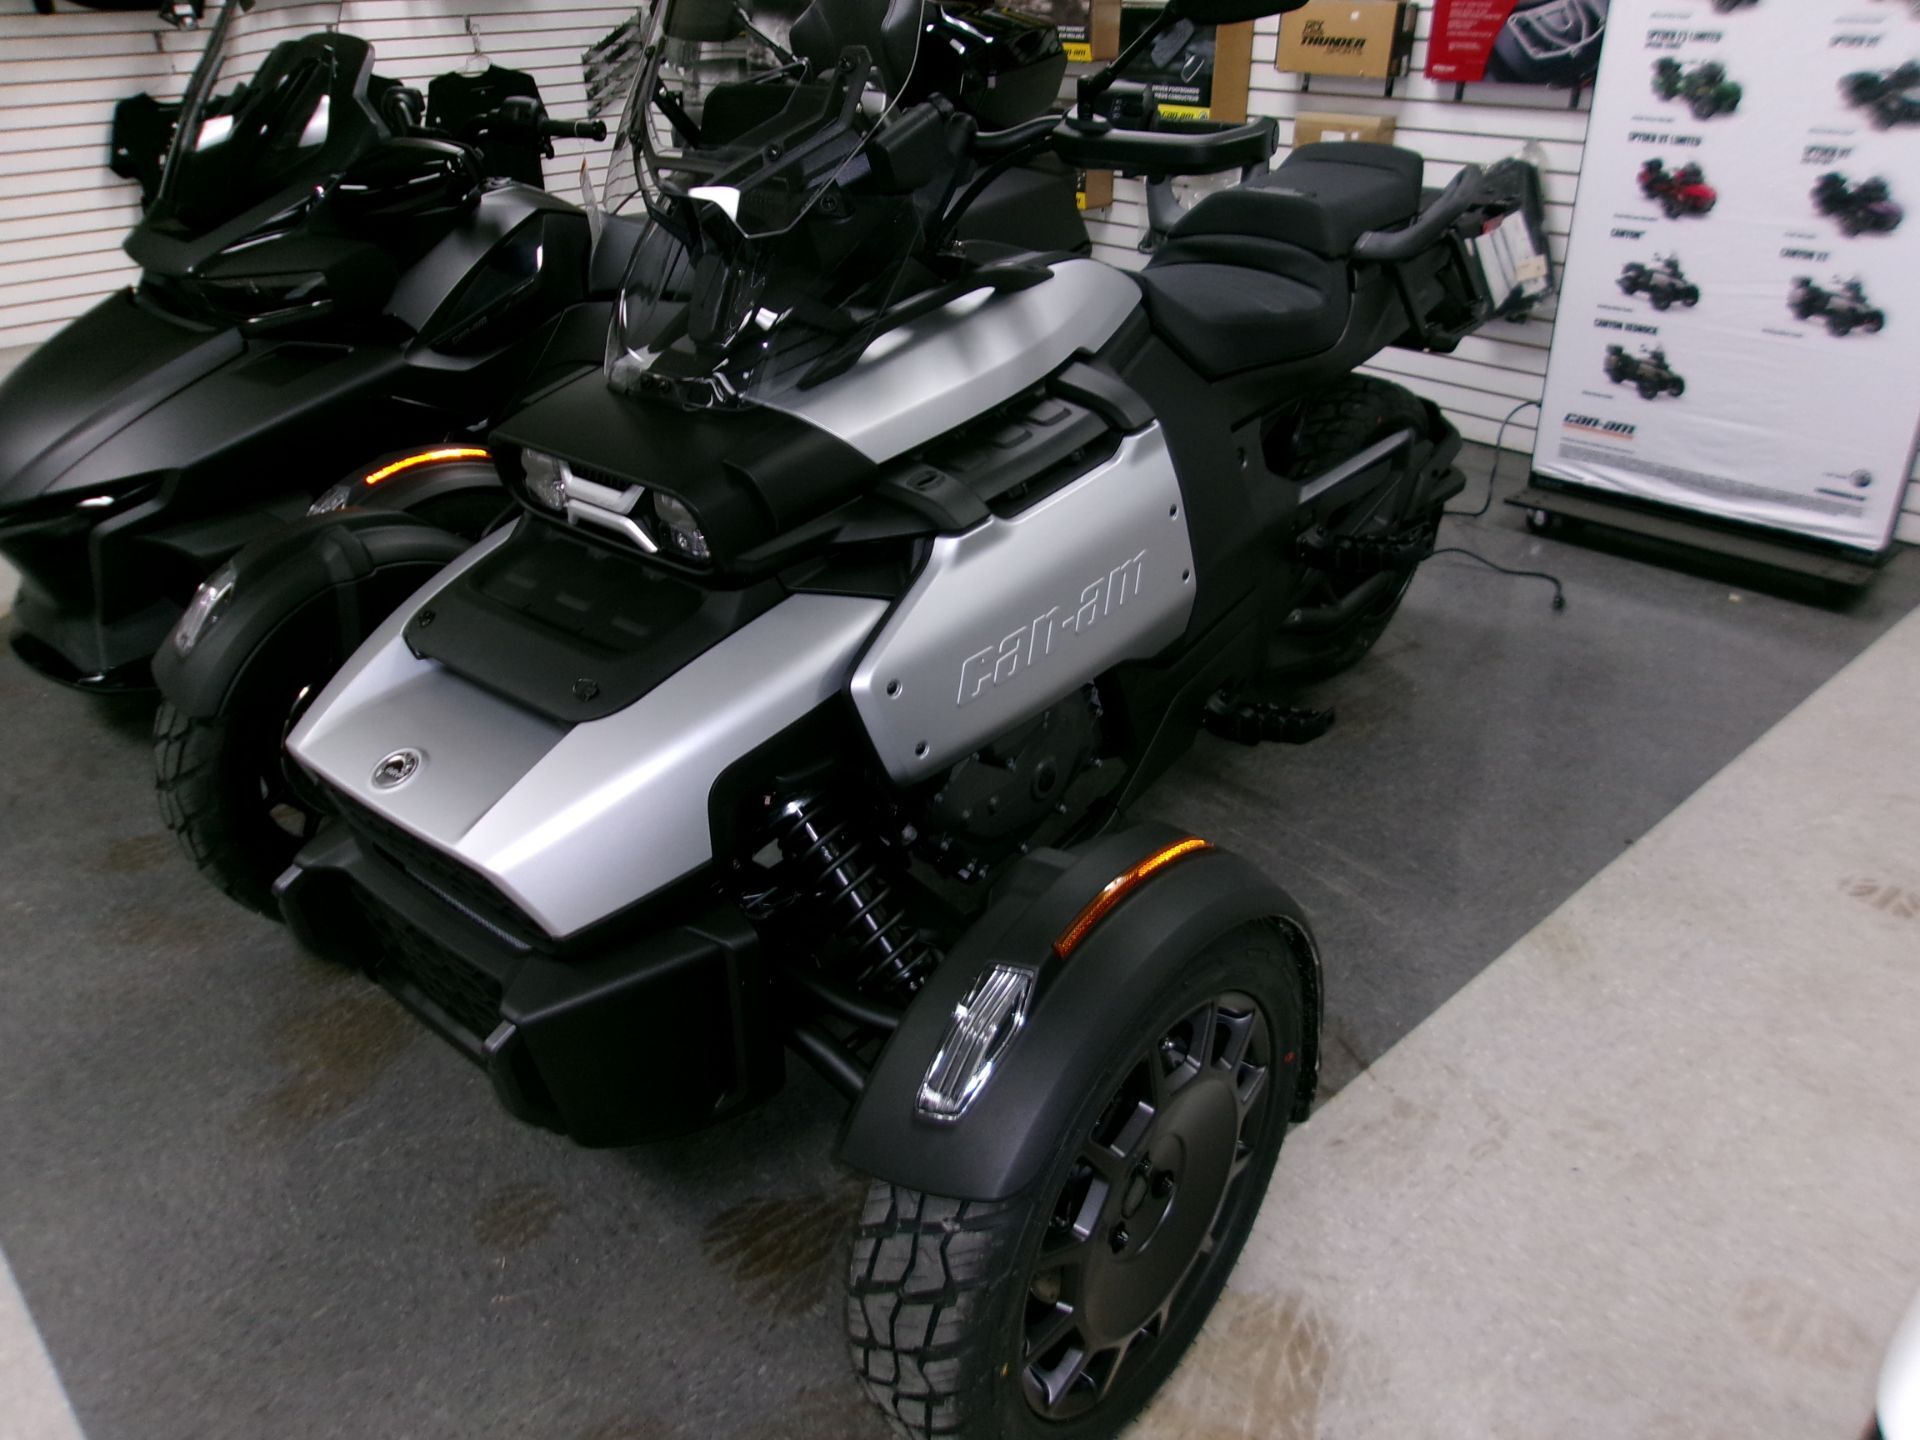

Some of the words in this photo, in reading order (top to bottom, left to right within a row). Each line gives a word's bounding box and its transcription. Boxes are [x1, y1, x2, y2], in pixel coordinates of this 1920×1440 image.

[1301, 35, 1366, 49] THUNDER
[1563, 412, 1636, 434] can-am
[956, 548, 1147, 705] can-am
